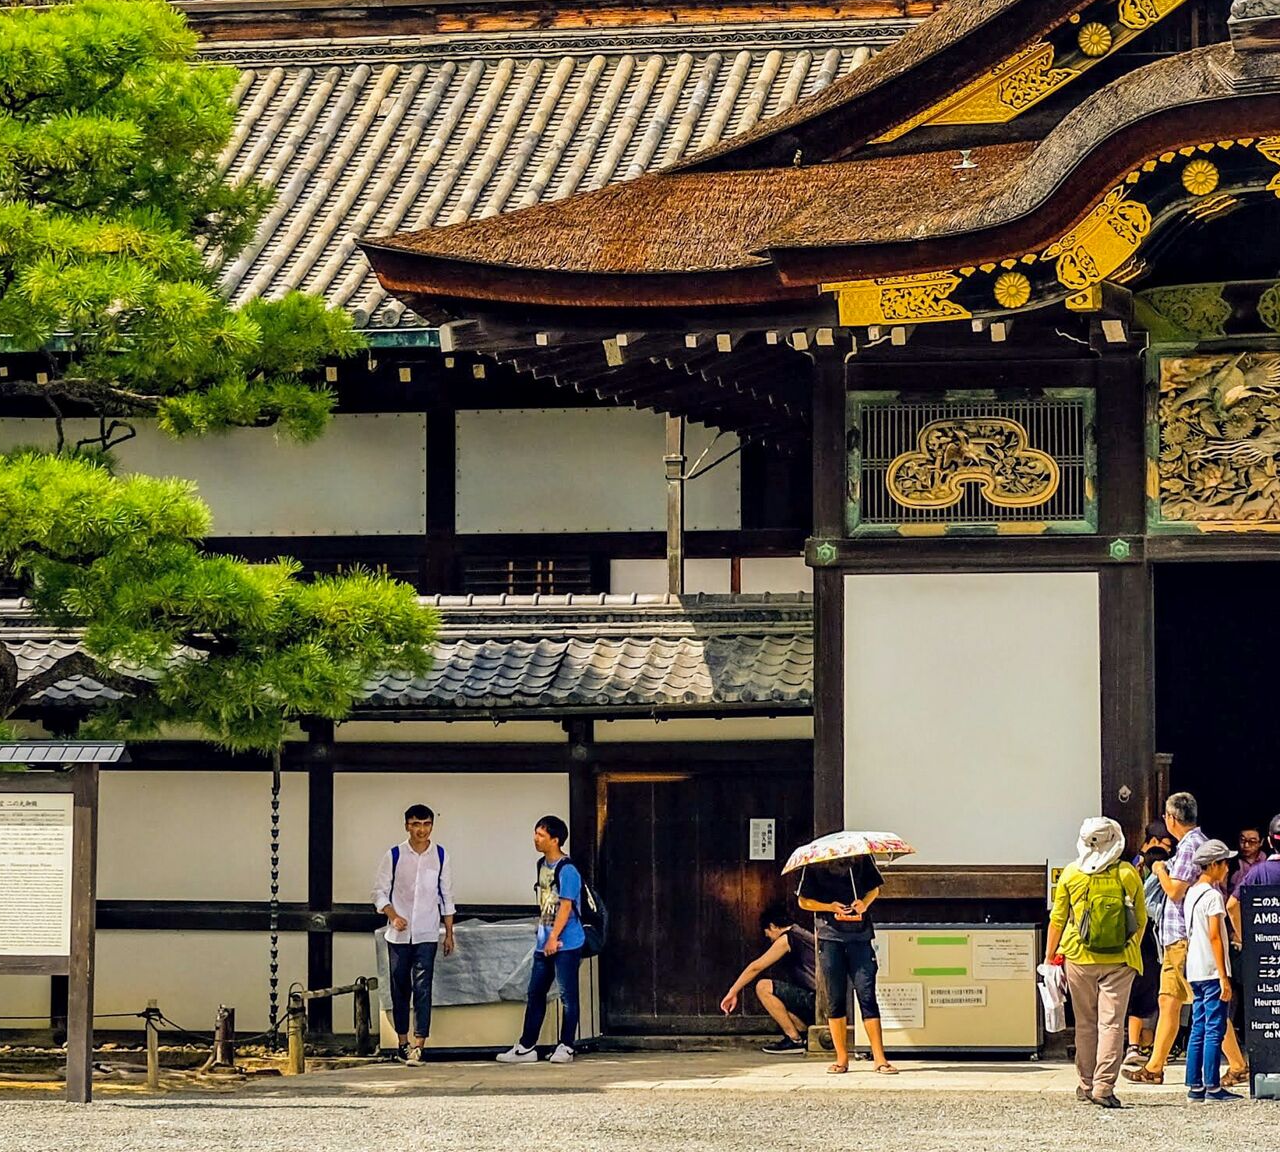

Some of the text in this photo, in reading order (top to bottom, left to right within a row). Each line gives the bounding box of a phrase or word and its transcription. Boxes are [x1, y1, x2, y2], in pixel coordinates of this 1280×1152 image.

[1254, 998, 1280, 1006] Heures
[1251, 1021, 1280, 1030] Horario
[1264, 1030, 1274, 1038] de
